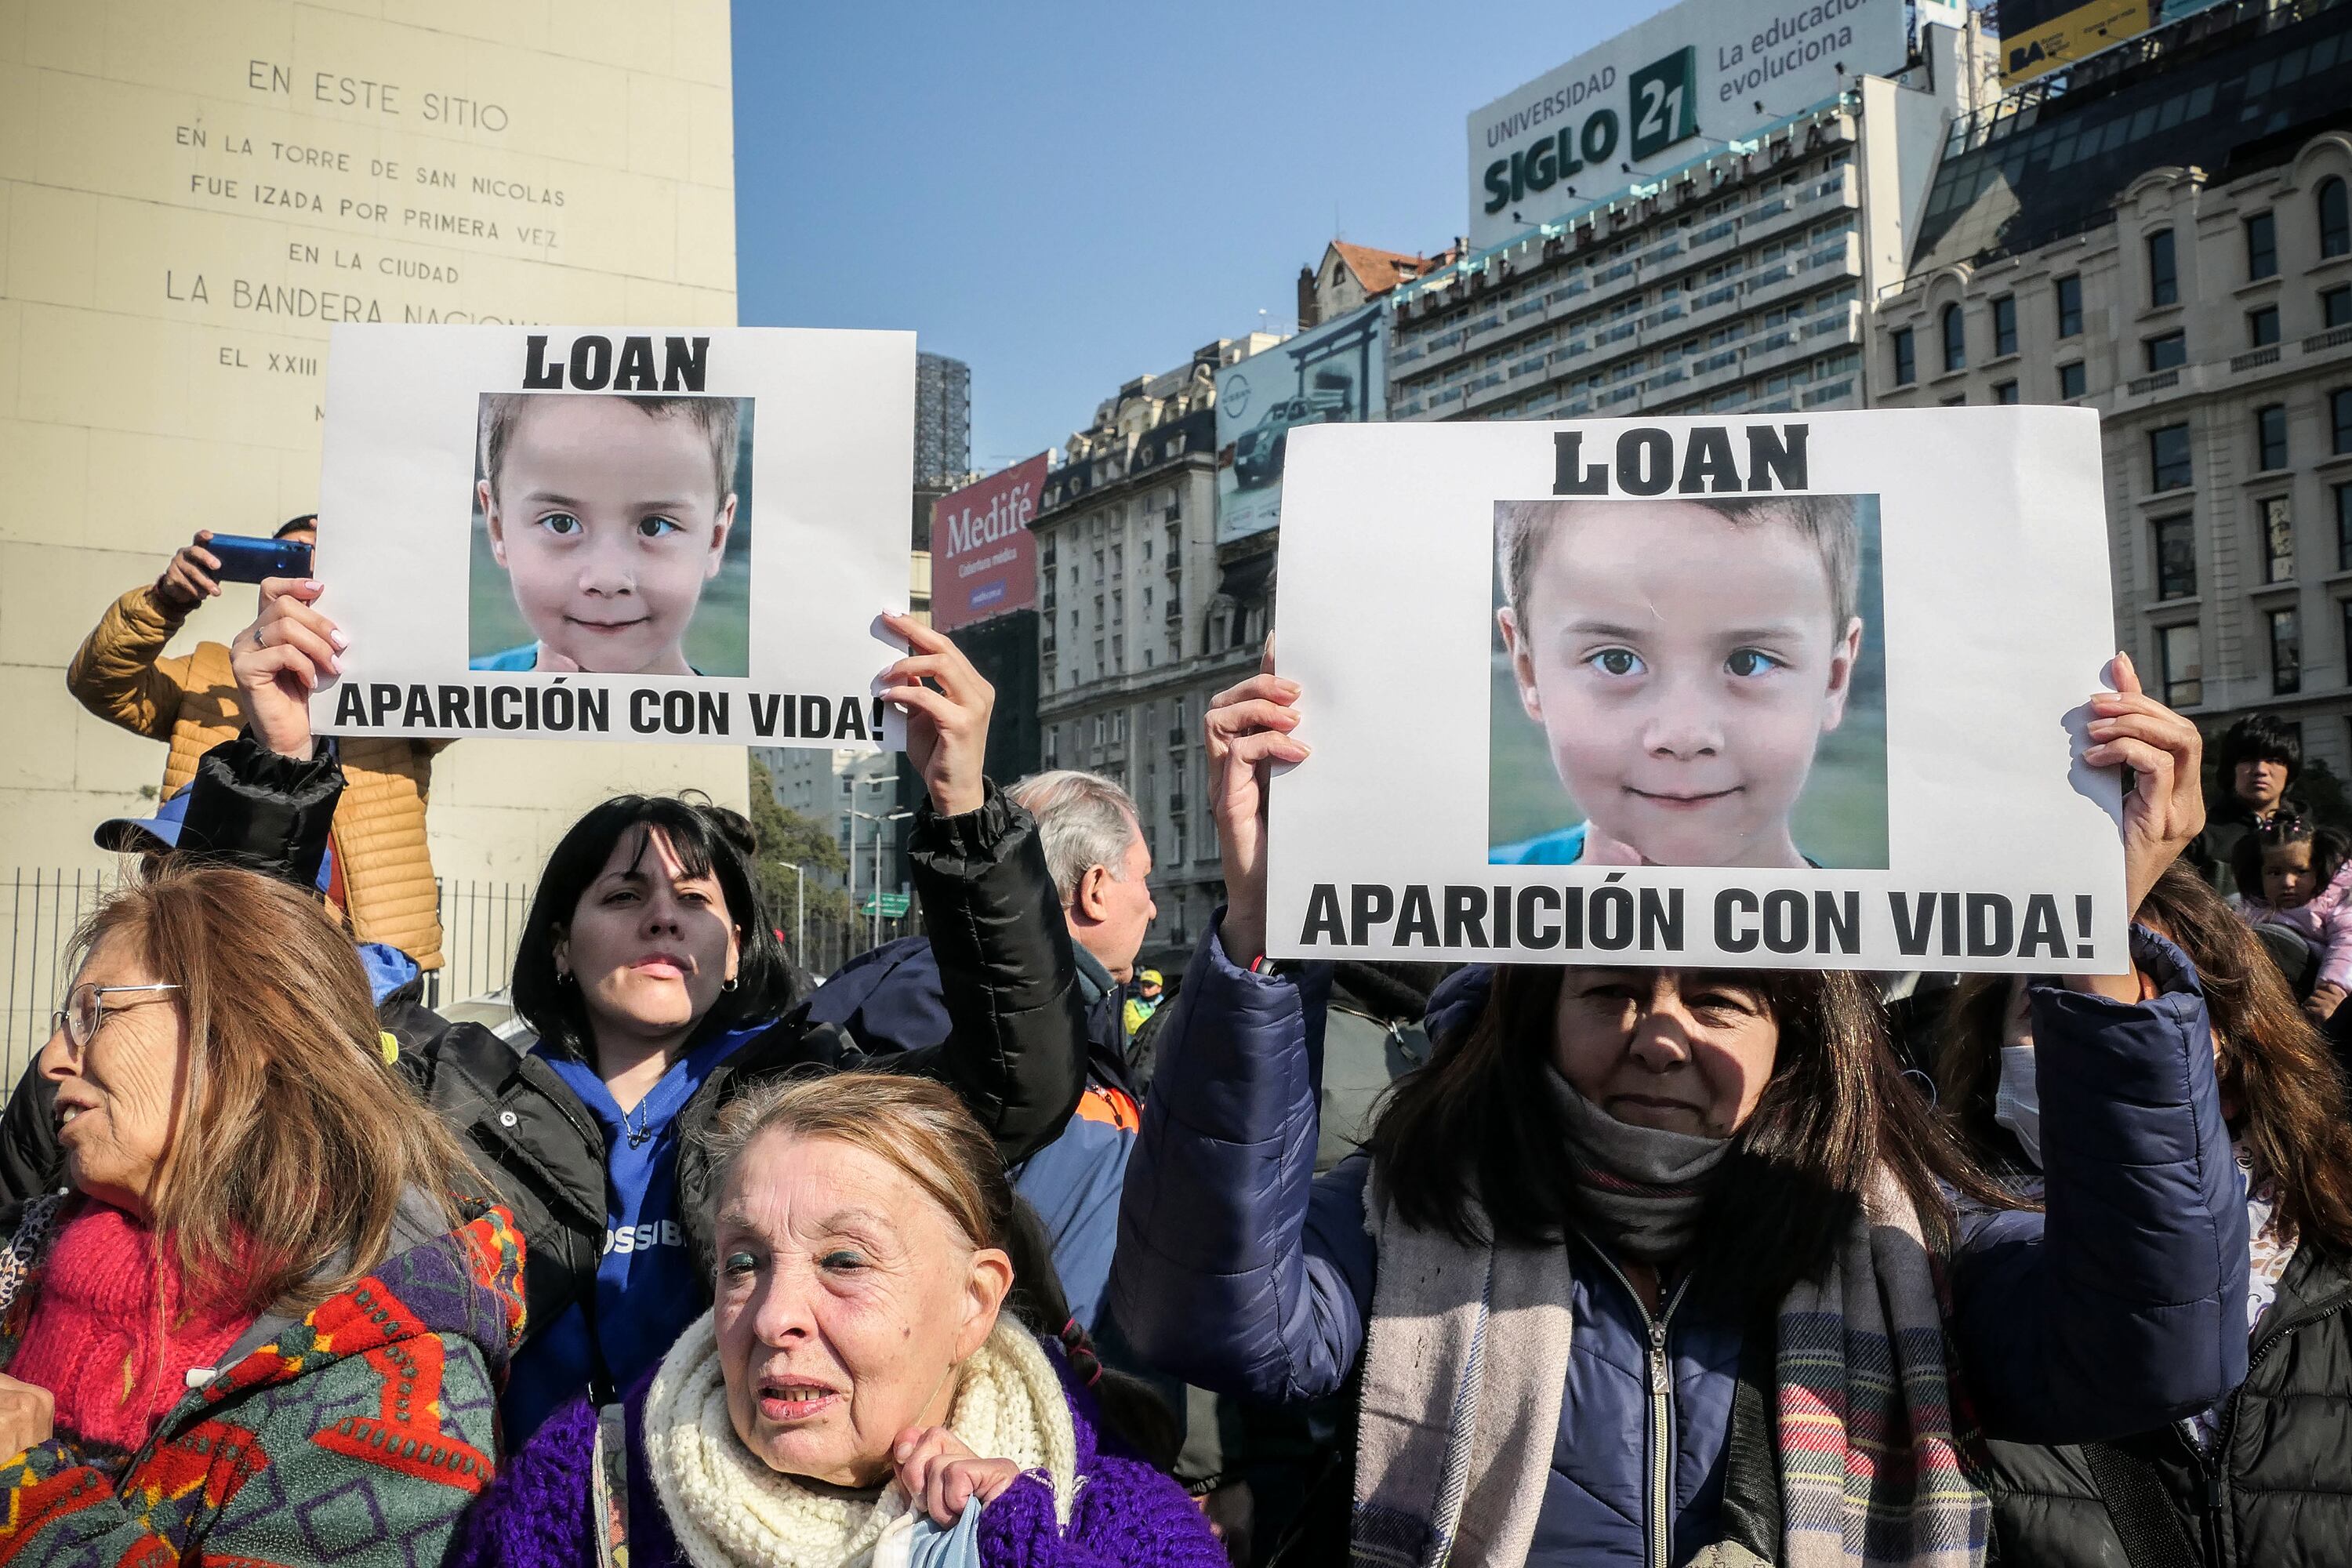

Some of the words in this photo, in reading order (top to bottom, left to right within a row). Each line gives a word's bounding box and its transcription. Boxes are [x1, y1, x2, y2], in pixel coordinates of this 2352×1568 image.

[1719, 45, 1744, 71] La
[1719, 25, 1853, 102] evoluciona
[249, 60, 290, 94] EN
[315, 72, 400, 114] ESTE
[423, 93, 509, 132] SITIO
[1486, 66, 1617, 148] UNIVERSIDAD
[176, 126, 207, 147] EN
[225, 135, 252, 156] LA
[271, 142, 350, 172] TORRE
[371, 159, 399, 180] DE
[416, 167, 456, 189] SAN
[472, 176, 564, 208] NICOLAS
[1484, 108, 1619, 215] SIGLO
[1637, 79, 1683, 142] 21
[191, 174, 238, 199] FUE
[255, 185, 323, 213] IZADA
[340, 199, 388, 223] POR
[404, 208, 499, 240] PRIMERA
[517, 227, 558, 249] VEZ
[166, 270, 209, 305] LA
[233, 279, 382, 323] BANDERA
[289, 243, 319, 264] EN
[334, 250, 362, 270] LA
[378, 257, 459, 285] CIUDAD
[219, 347, 249, 368] EL
[268, 353, 318, 376] XXIII
[523, 336, 709, 391] LOAN
[1552, 423, 1809, 495] LOAN
[946, 481, 1032, 558] Medifé
[335, 677, 609, 731] APARICIÓN
[630, 689, 728, 735] CON
[749, 694, 884, 741] VIDA!
[1300, 873, 1683, 950] APARICIÓN
[1715, 888, 1860, 954] CON
[1888, 892, 2093, 958] VIDA!
